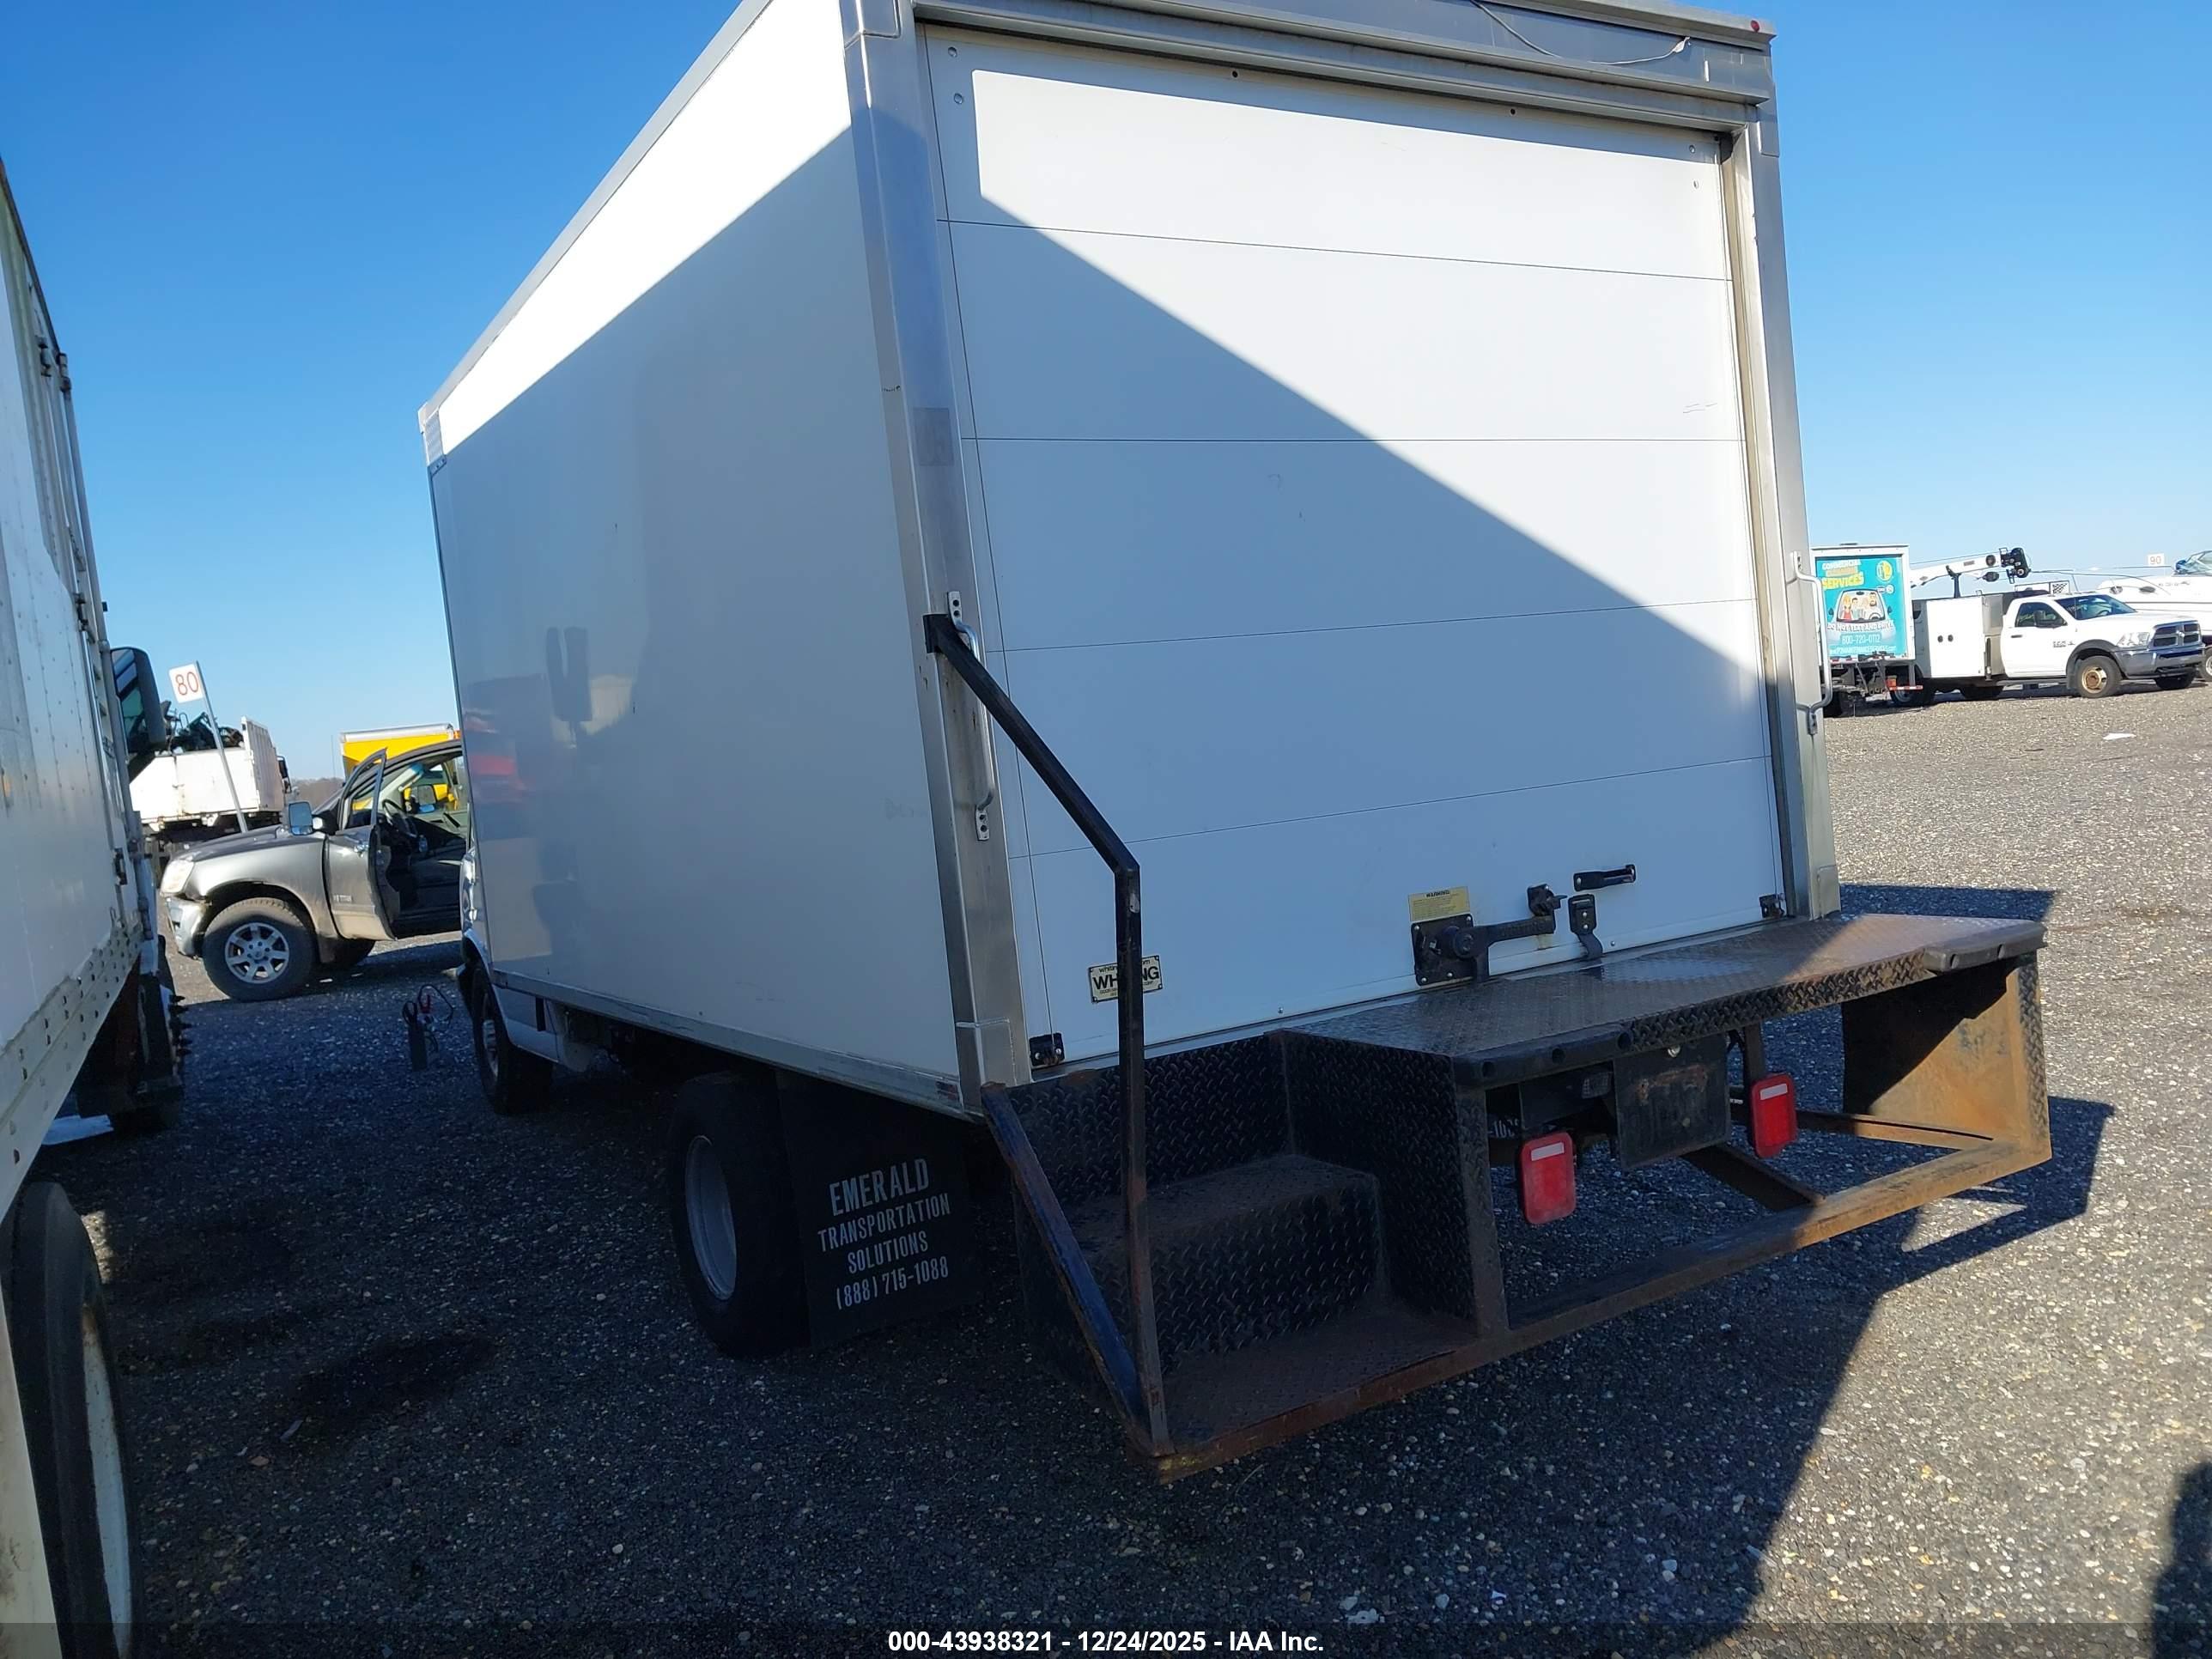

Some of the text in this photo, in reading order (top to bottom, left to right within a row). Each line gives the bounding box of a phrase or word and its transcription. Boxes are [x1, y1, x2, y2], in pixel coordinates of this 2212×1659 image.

[175, 671, 198, 696] 80
[1092, 966, 1159, 989] WHNG
[829, 1158, 929, 1217] EMERALD
[817, 1193, 951, 1253] TRANSPORTATION
[847, 1230, 928, 1274] SOLUTIONS
[836, 1255, 949, 1310] (888) 715-1088
